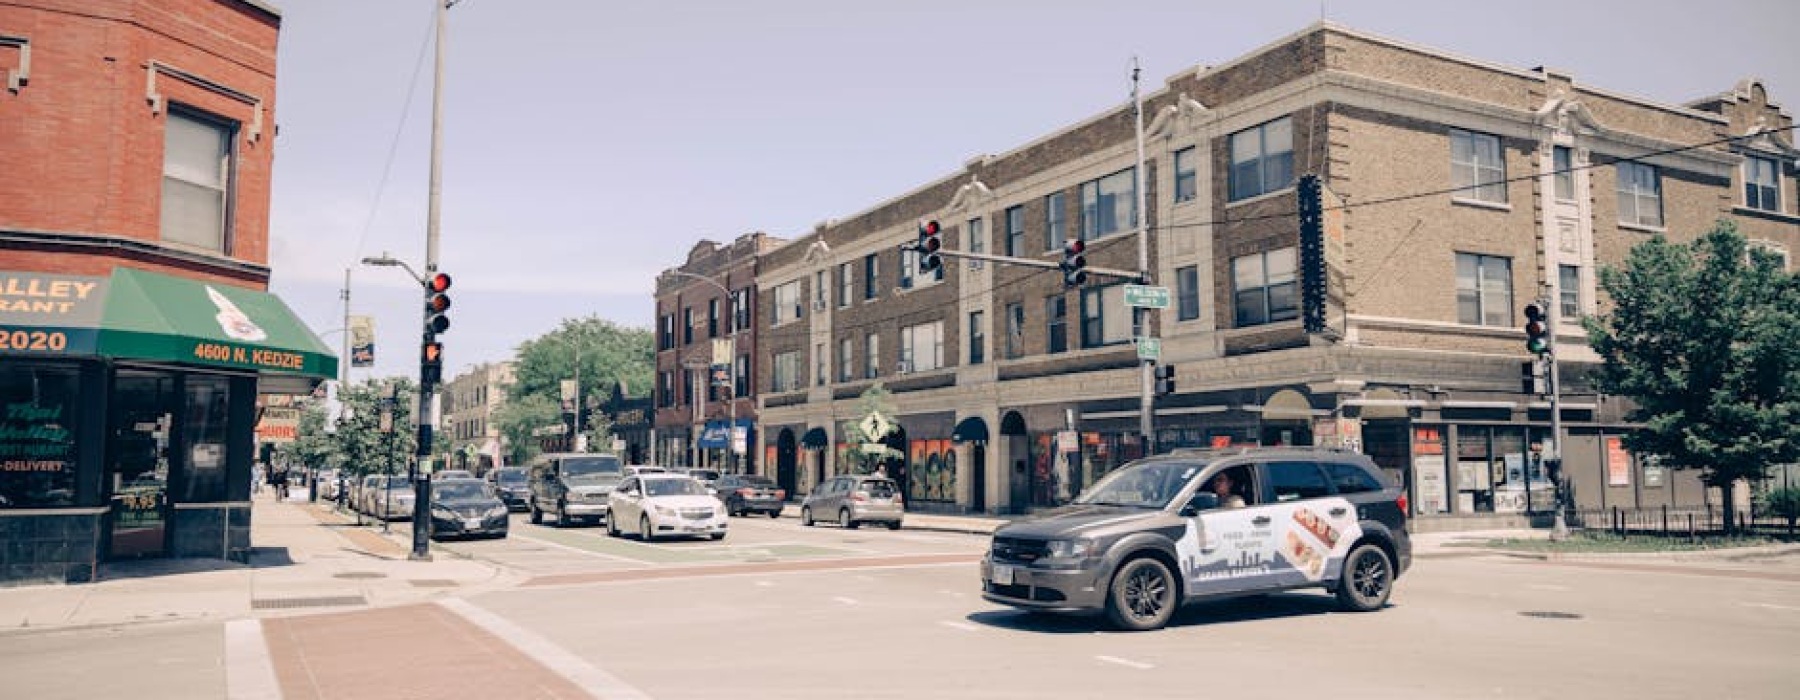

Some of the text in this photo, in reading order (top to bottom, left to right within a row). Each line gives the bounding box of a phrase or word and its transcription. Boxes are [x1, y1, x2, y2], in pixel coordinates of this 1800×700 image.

[0, 278, 97, 300] LLEY
[0, 330, 67, 350] 2020
[195, 343, 231, 361] 4600
[252, 349, 304, 370] KEDZIE
